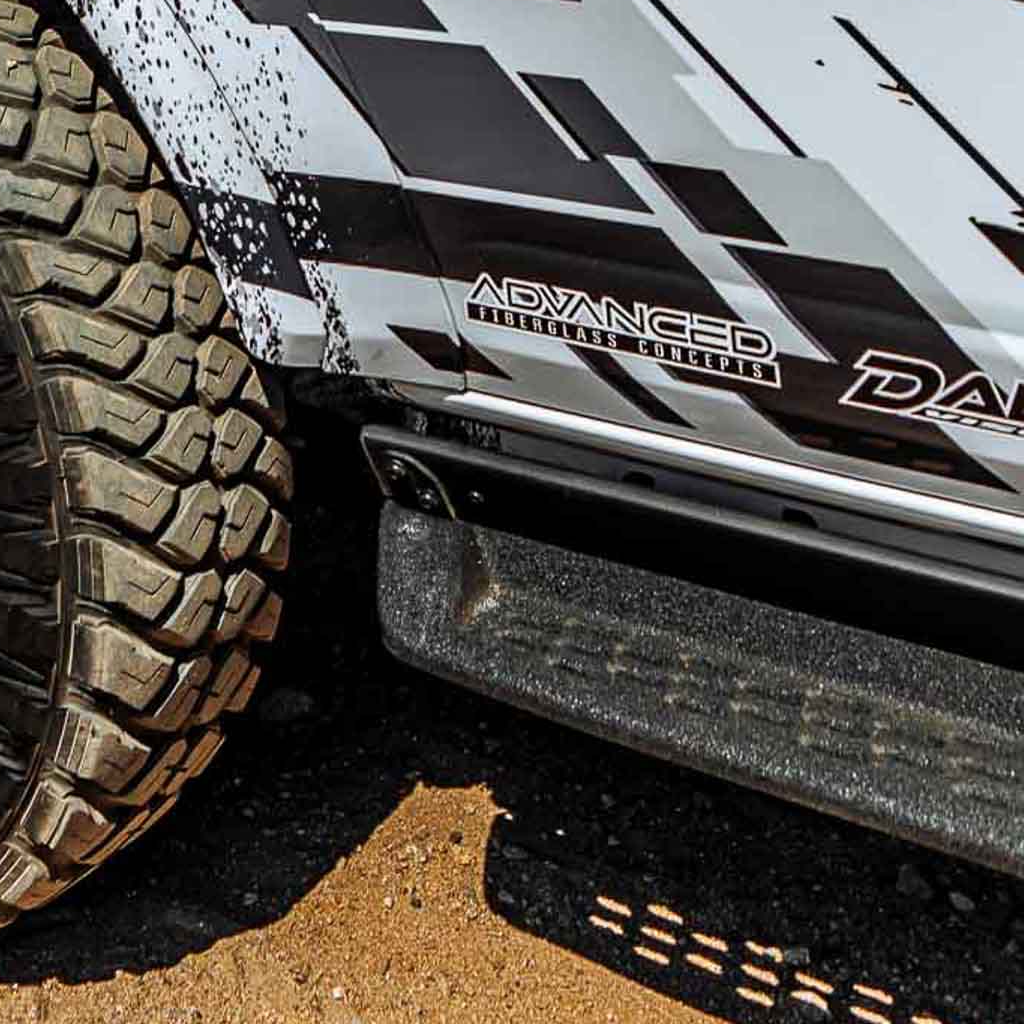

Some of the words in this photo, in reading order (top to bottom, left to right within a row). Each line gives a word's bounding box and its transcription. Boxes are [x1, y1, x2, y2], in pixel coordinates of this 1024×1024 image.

[468, 273, 777, 364] ADVANCED
[479, 306, 618, 349] FIBERGLASS
[637, 339, 764, 379] CONCEPTS
[838, 349, 1024, 423] DA
